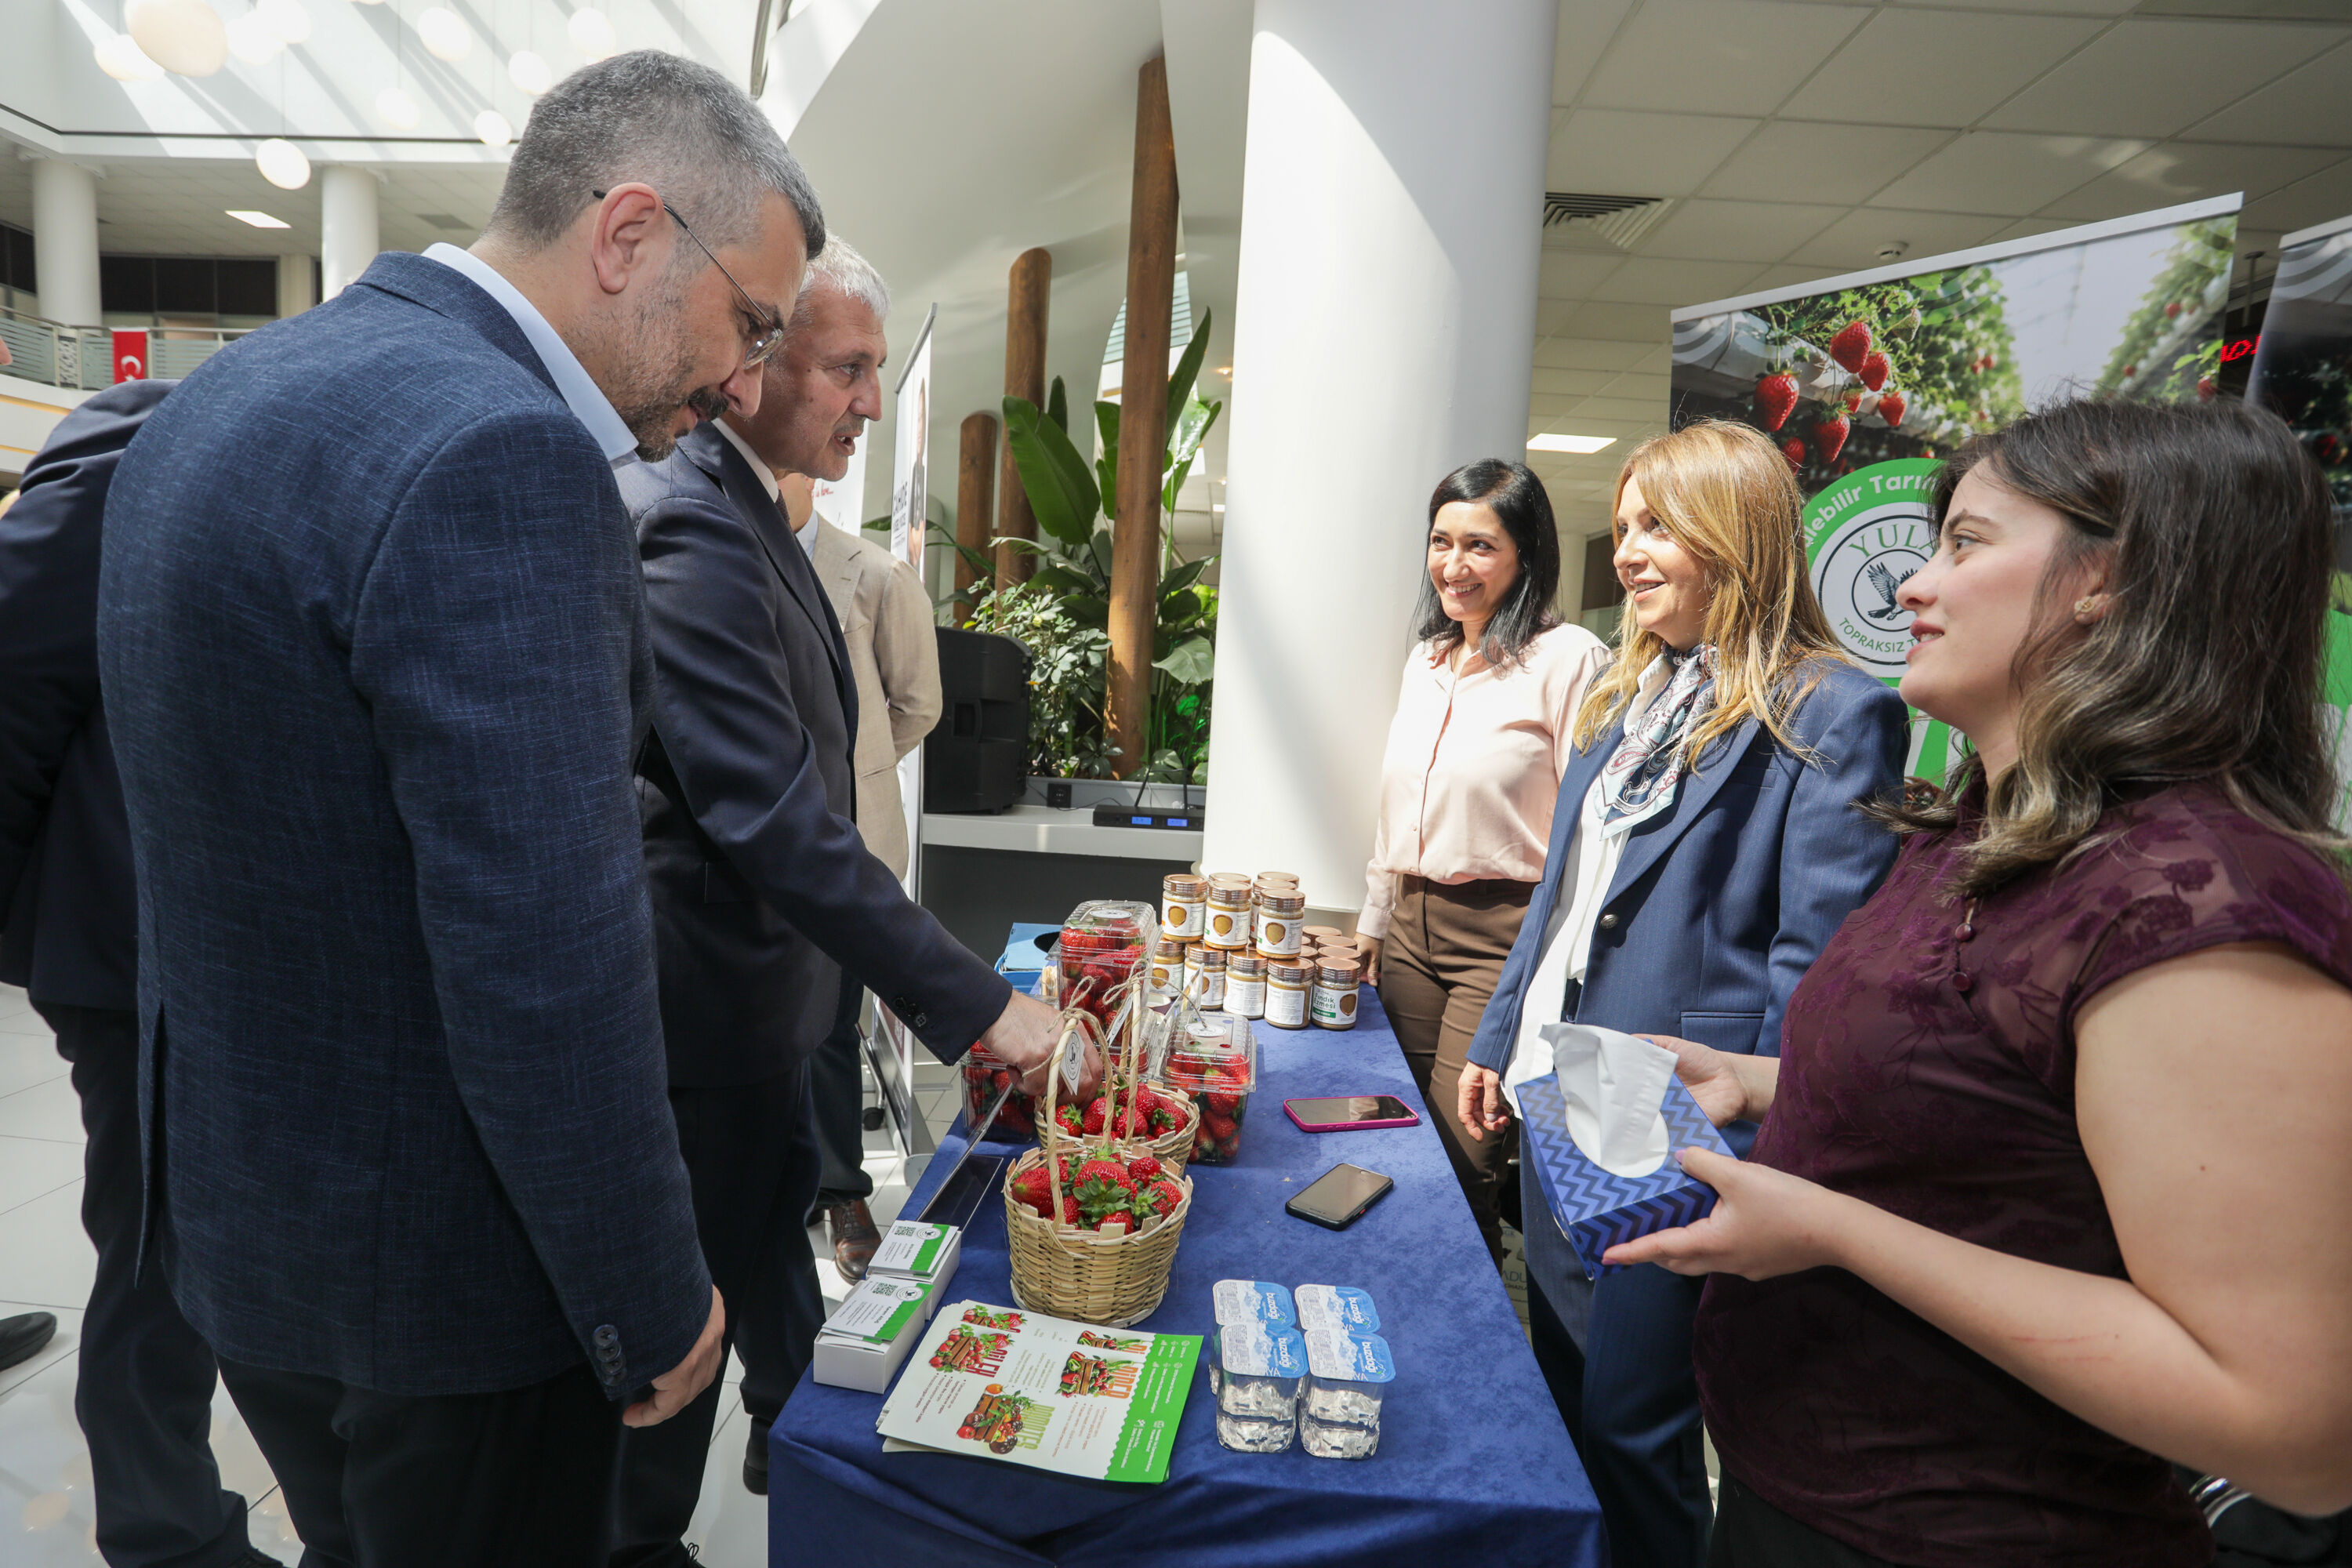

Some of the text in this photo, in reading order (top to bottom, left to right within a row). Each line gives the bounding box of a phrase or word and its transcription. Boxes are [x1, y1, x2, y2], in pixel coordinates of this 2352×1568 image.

[1839, 617, 1905, 653] TOPRAKSIZ
[1265, 1292, 1279, 1320] buzdağı
[1348, 1297, 1363, 1325] buzdağı
[1277, 1338, 1290, 1368] buzdağı
[1361, 1341, 1377, 1374] buzdağı
